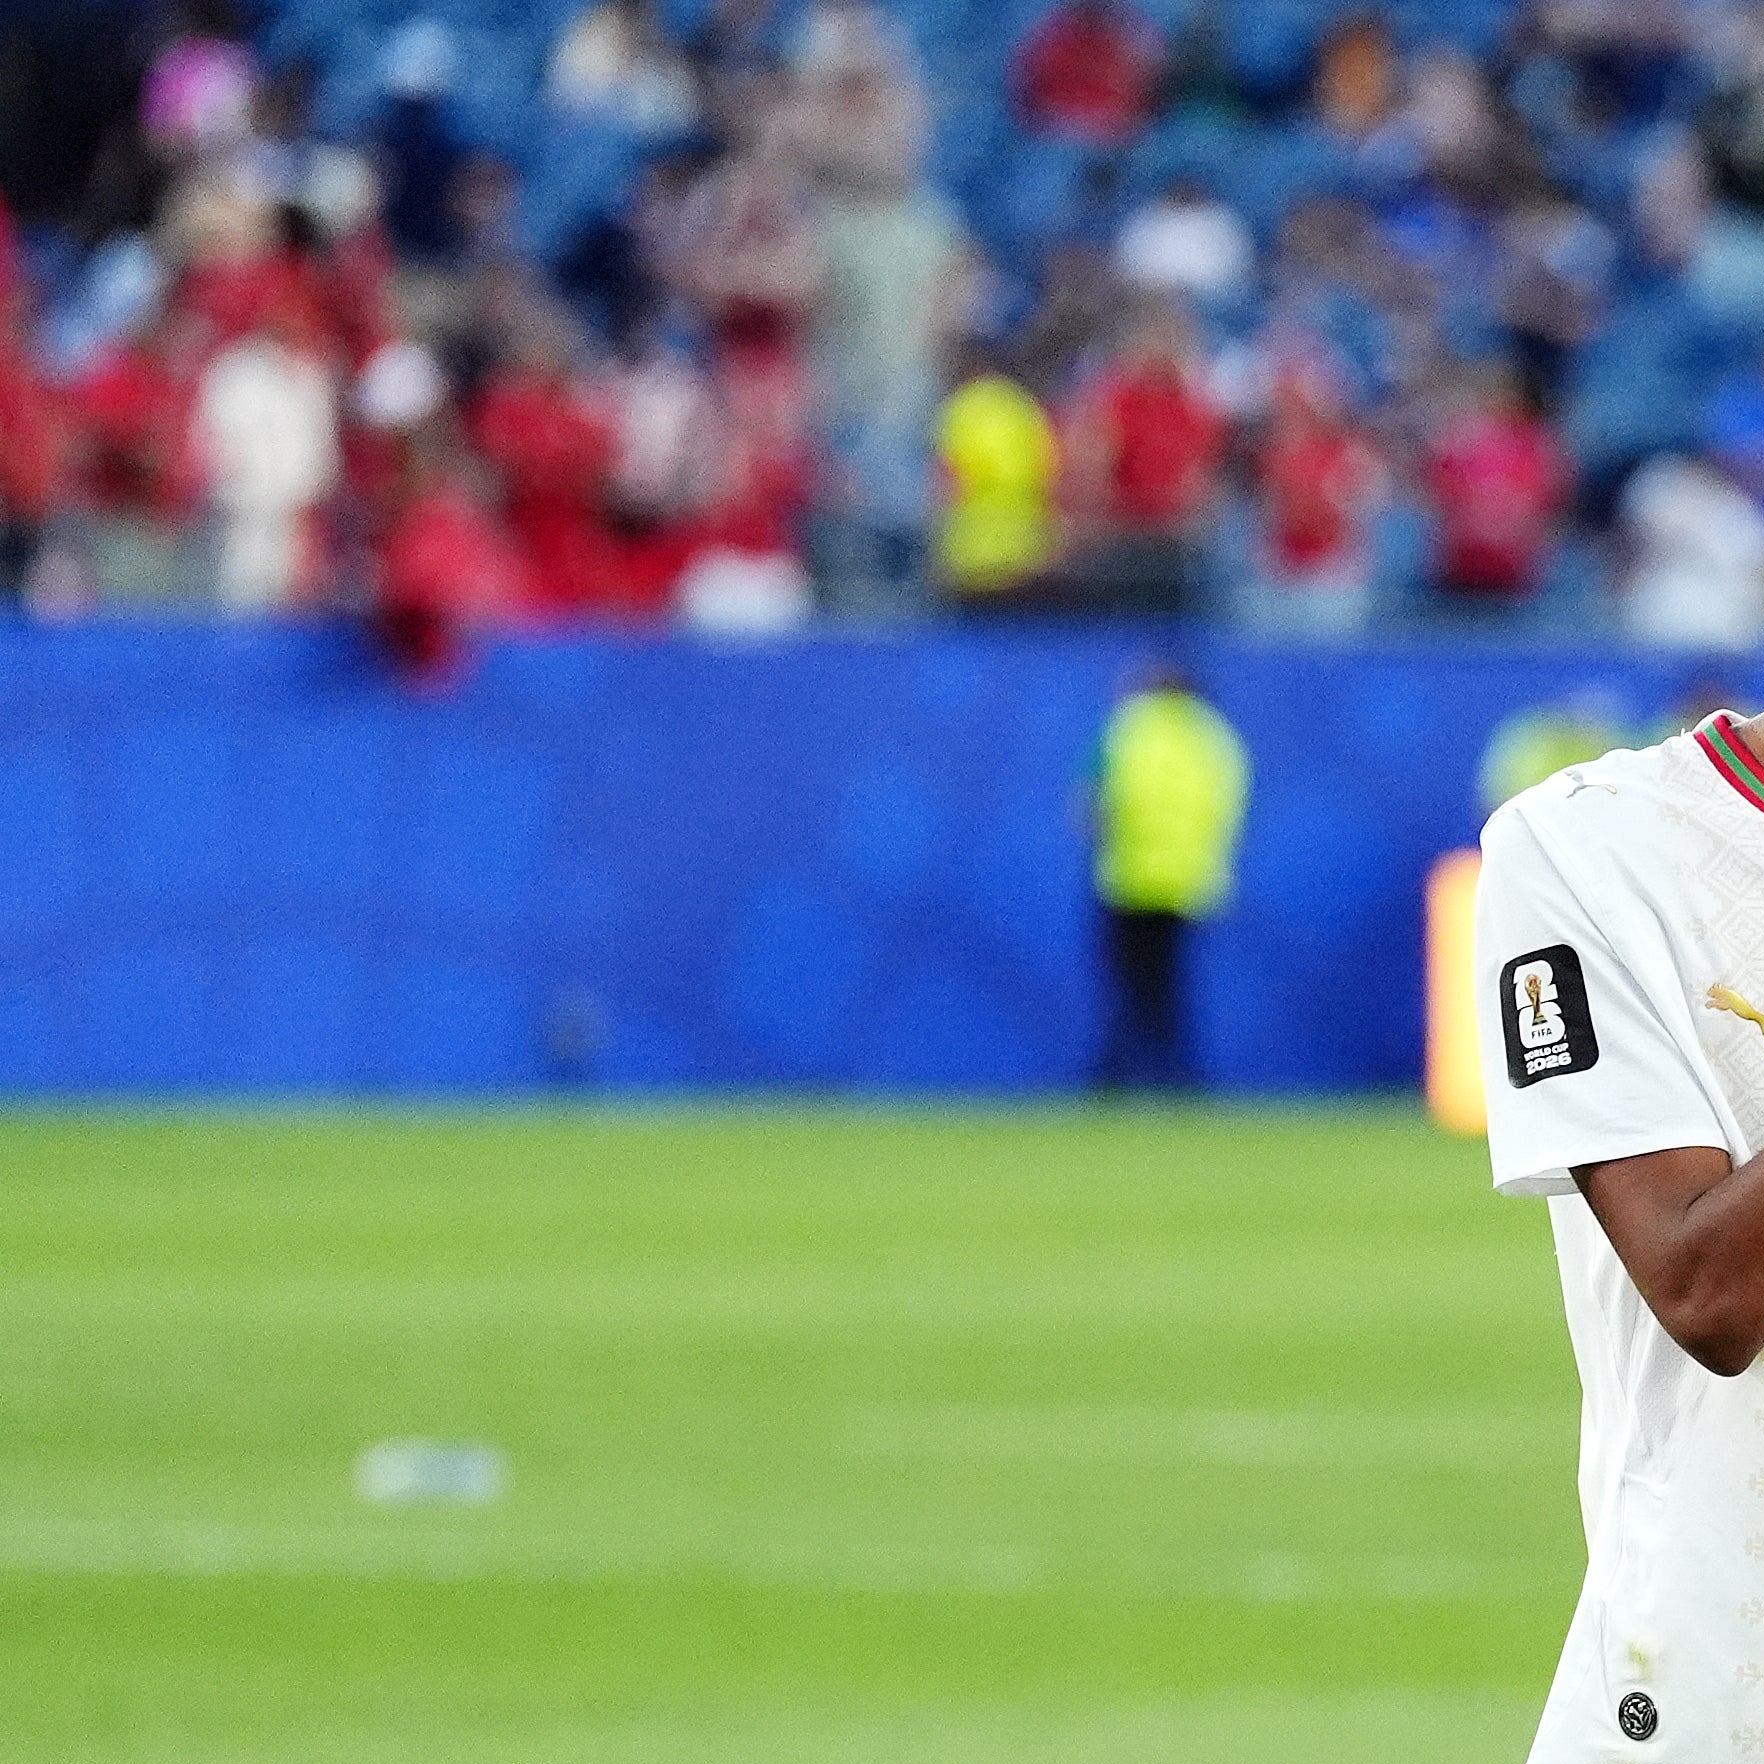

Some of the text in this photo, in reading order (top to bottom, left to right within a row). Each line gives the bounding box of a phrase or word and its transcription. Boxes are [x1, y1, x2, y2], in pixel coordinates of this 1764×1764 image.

[1530, 1026, 1553, 1040] FIFA
[1523, 1042, 1569, 1062] WORLD CUP
[1525, 1052, 1571, 1075] 2026
